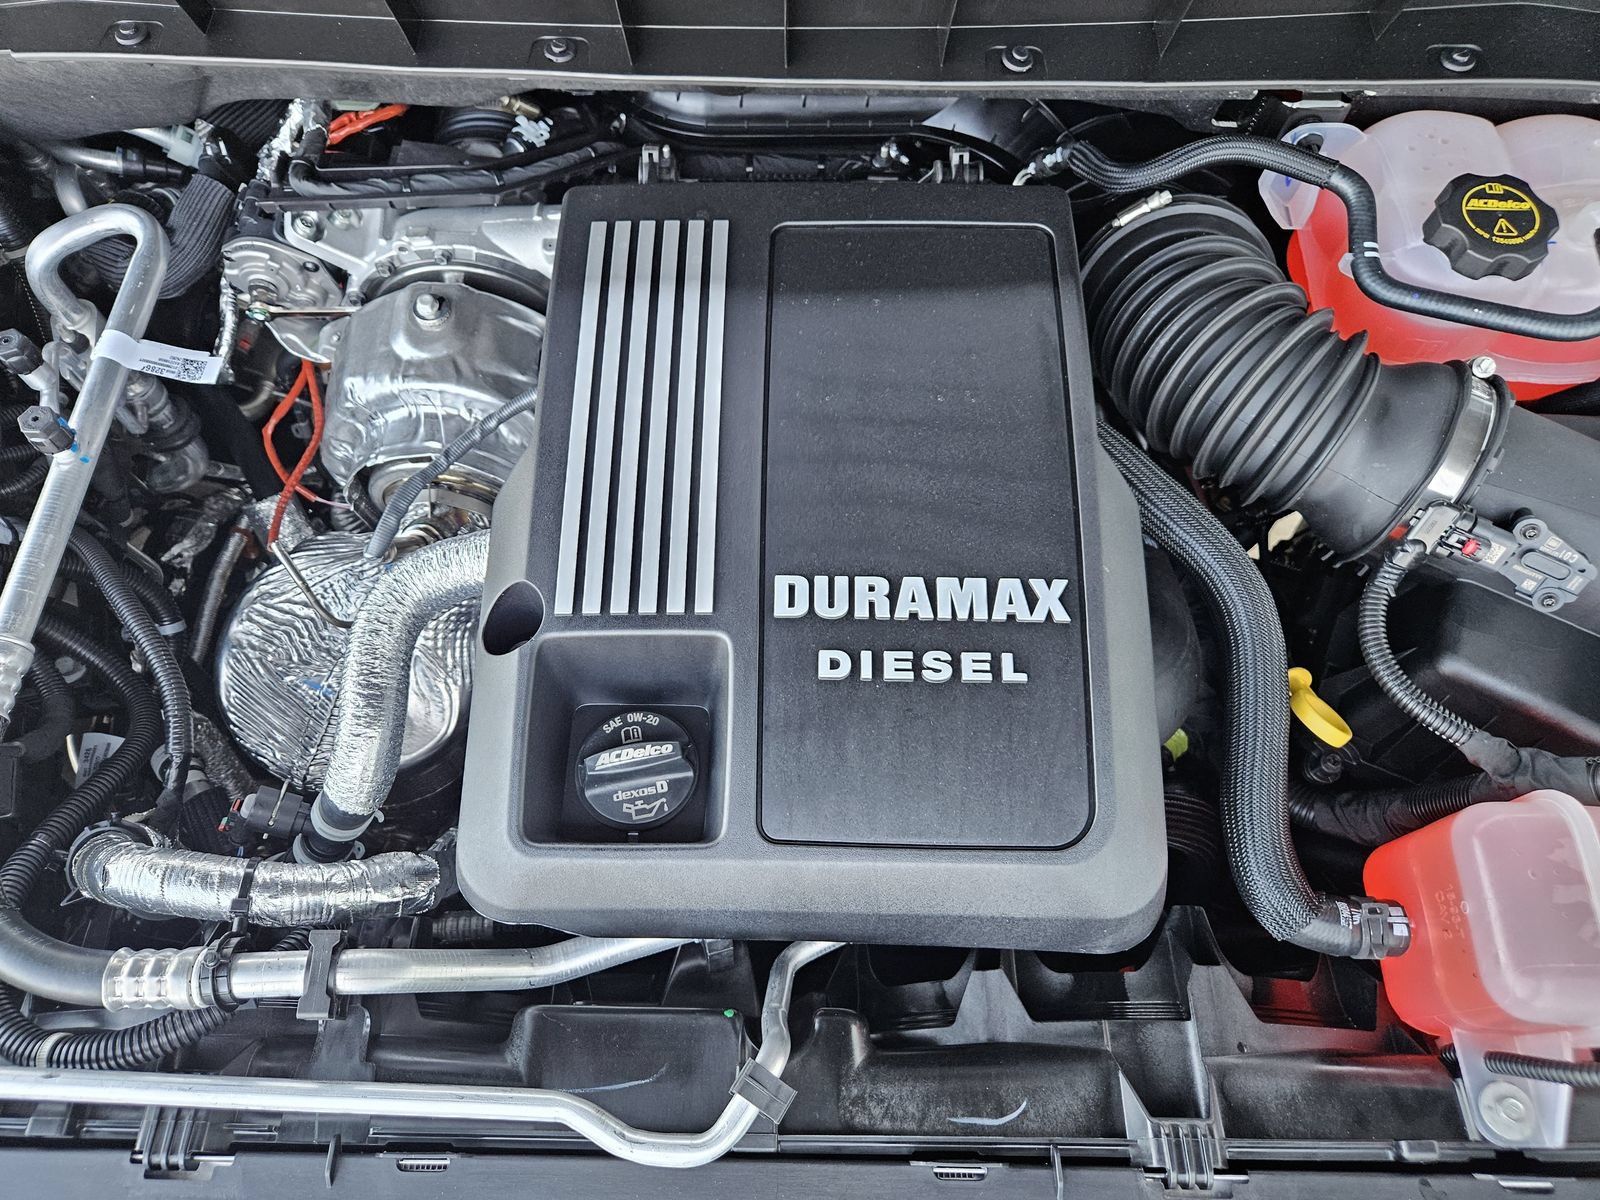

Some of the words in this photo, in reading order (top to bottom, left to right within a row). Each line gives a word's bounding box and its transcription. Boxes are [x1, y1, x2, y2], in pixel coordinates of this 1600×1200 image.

[1466, 198, 1531, 209] ACDelco
[773, 574, 1072, 624] DURAMAX
[817, 649, 1029, 684] DIESEL
[602, 716, 624, 734] SAE
[626, 712, 660, 726] 0W-20
[594, 743, 674, 768] ACDelco
